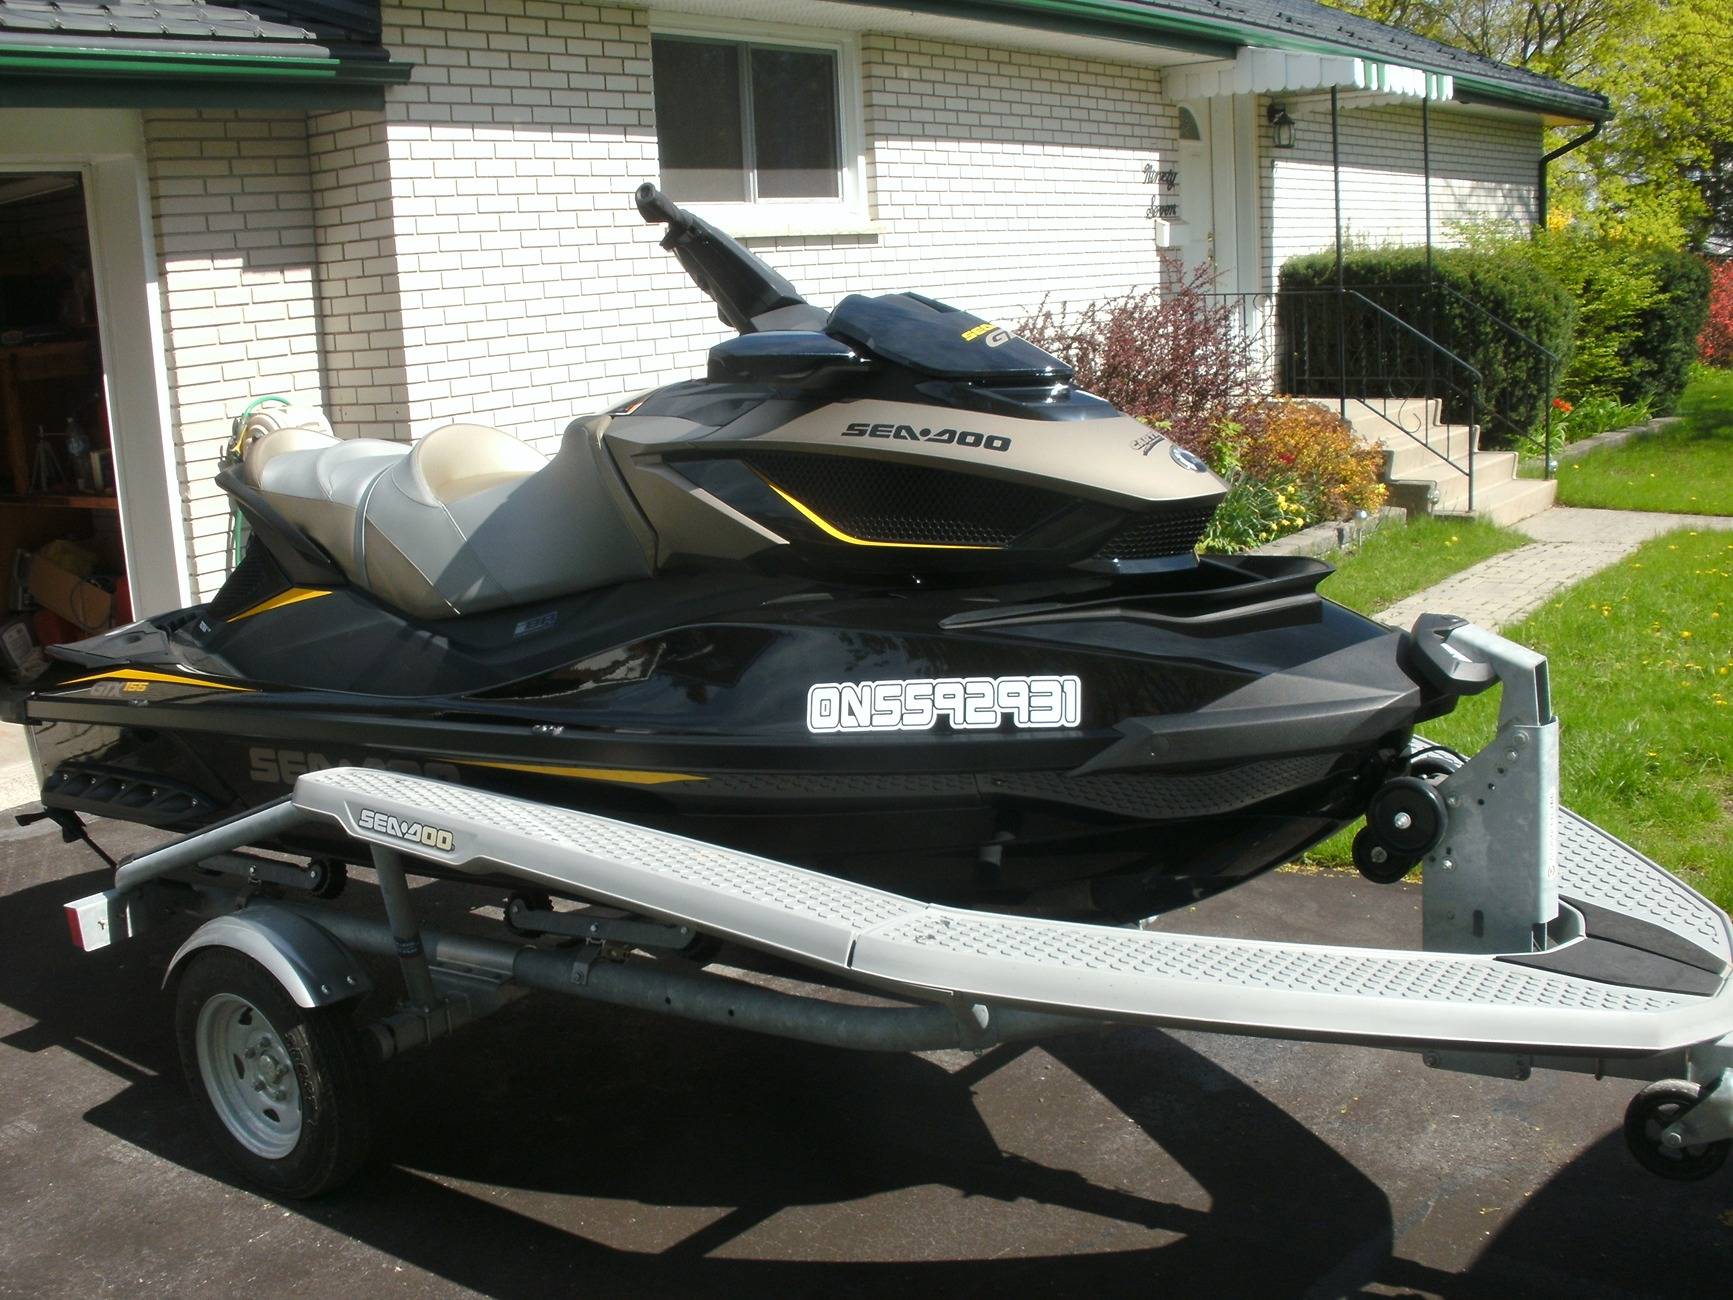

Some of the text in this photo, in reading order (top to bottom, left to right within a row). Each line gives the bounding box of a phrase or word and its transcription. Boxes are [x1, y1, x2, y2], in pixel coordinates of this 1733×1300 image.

[1142, 163, 1178, 191] Ninety
[1145, 194, 1177, 219] Seven
[807, 675, 1081, 733] ON5592931
